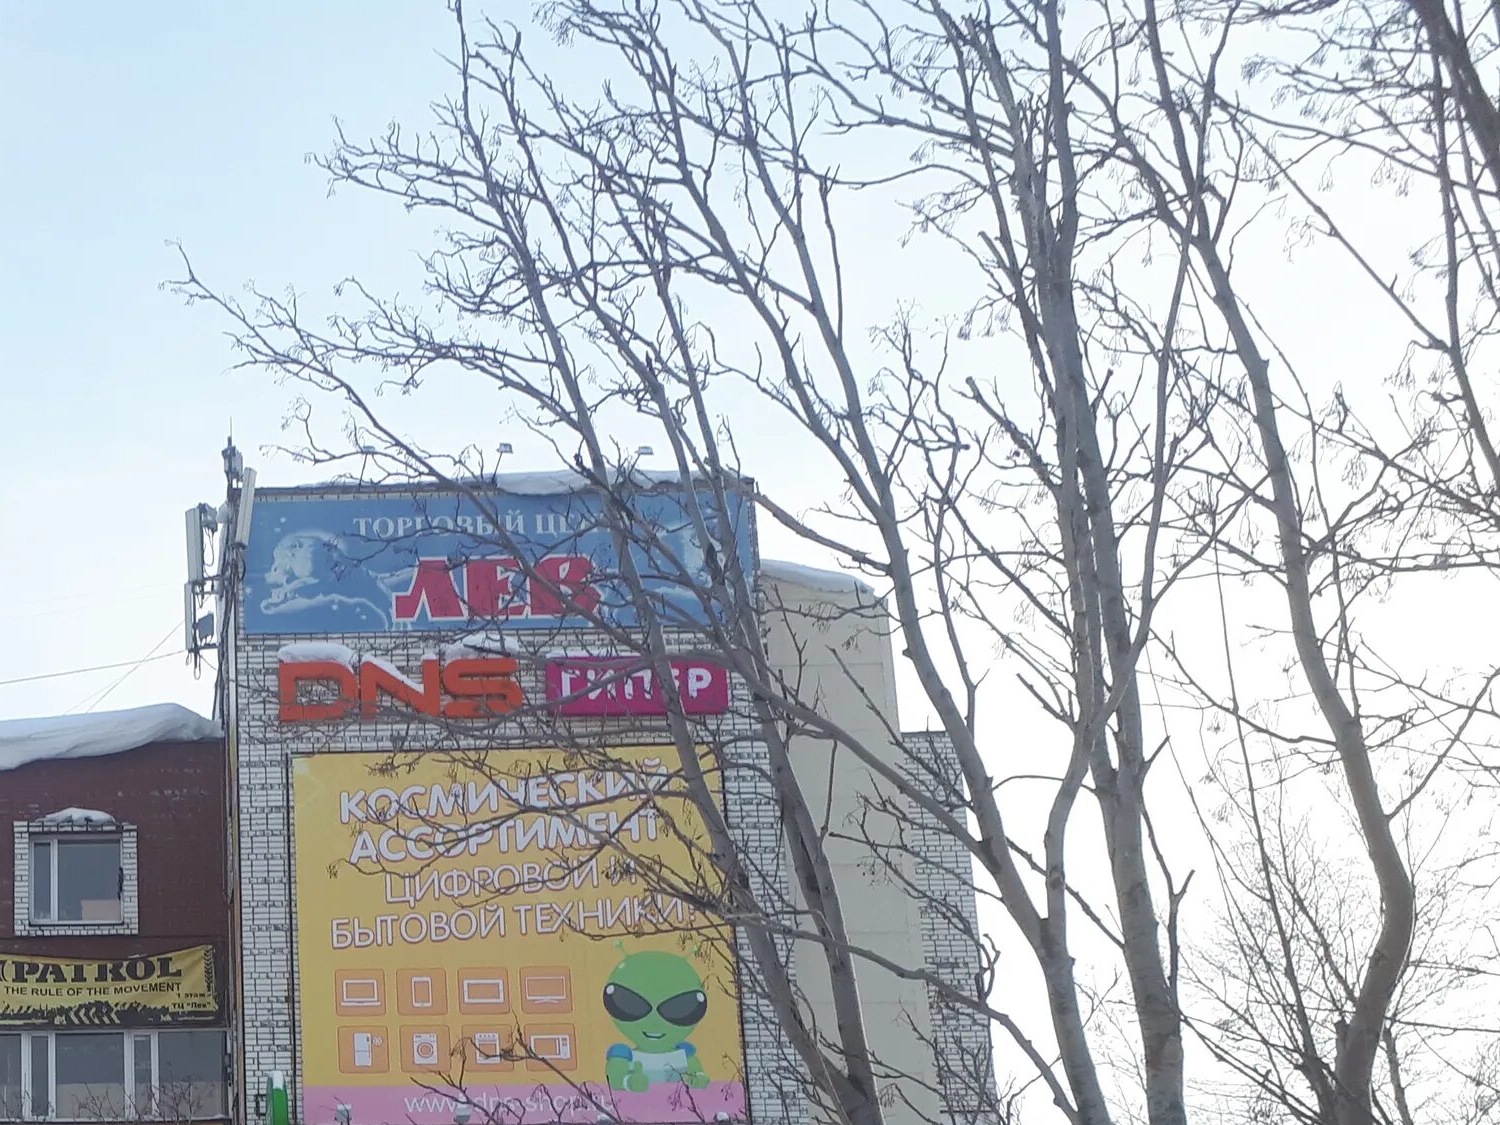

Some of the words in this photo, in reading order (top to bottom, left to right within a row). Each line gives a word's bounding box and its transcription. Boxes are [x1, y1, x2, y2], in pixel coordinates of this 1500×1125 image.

[353, 509, 526, 538] ТОРГОВЫЙ
[392, 553, 605, 622] ЛЕВ
[279, 656, 524, 722] DNS
[339, 758, 669, 825] КОСМИЧЕСКИЙ
[349, 807, 658, 865] АССОРТИМЕНТ
[385, 853, 599, 909] ЦИФРОВОЙ
[331, 901, 506, 949] БЫТОВОЙ
[3, 985, 28, 996] THE
[31, 986, 64, 997] RULE
[66, 987, 84, 997] OF
[86, 986, 111, 996] THE
[113, 982, 183, 995] MOVEMENT
[11, 956, 183, 983] PATROL
